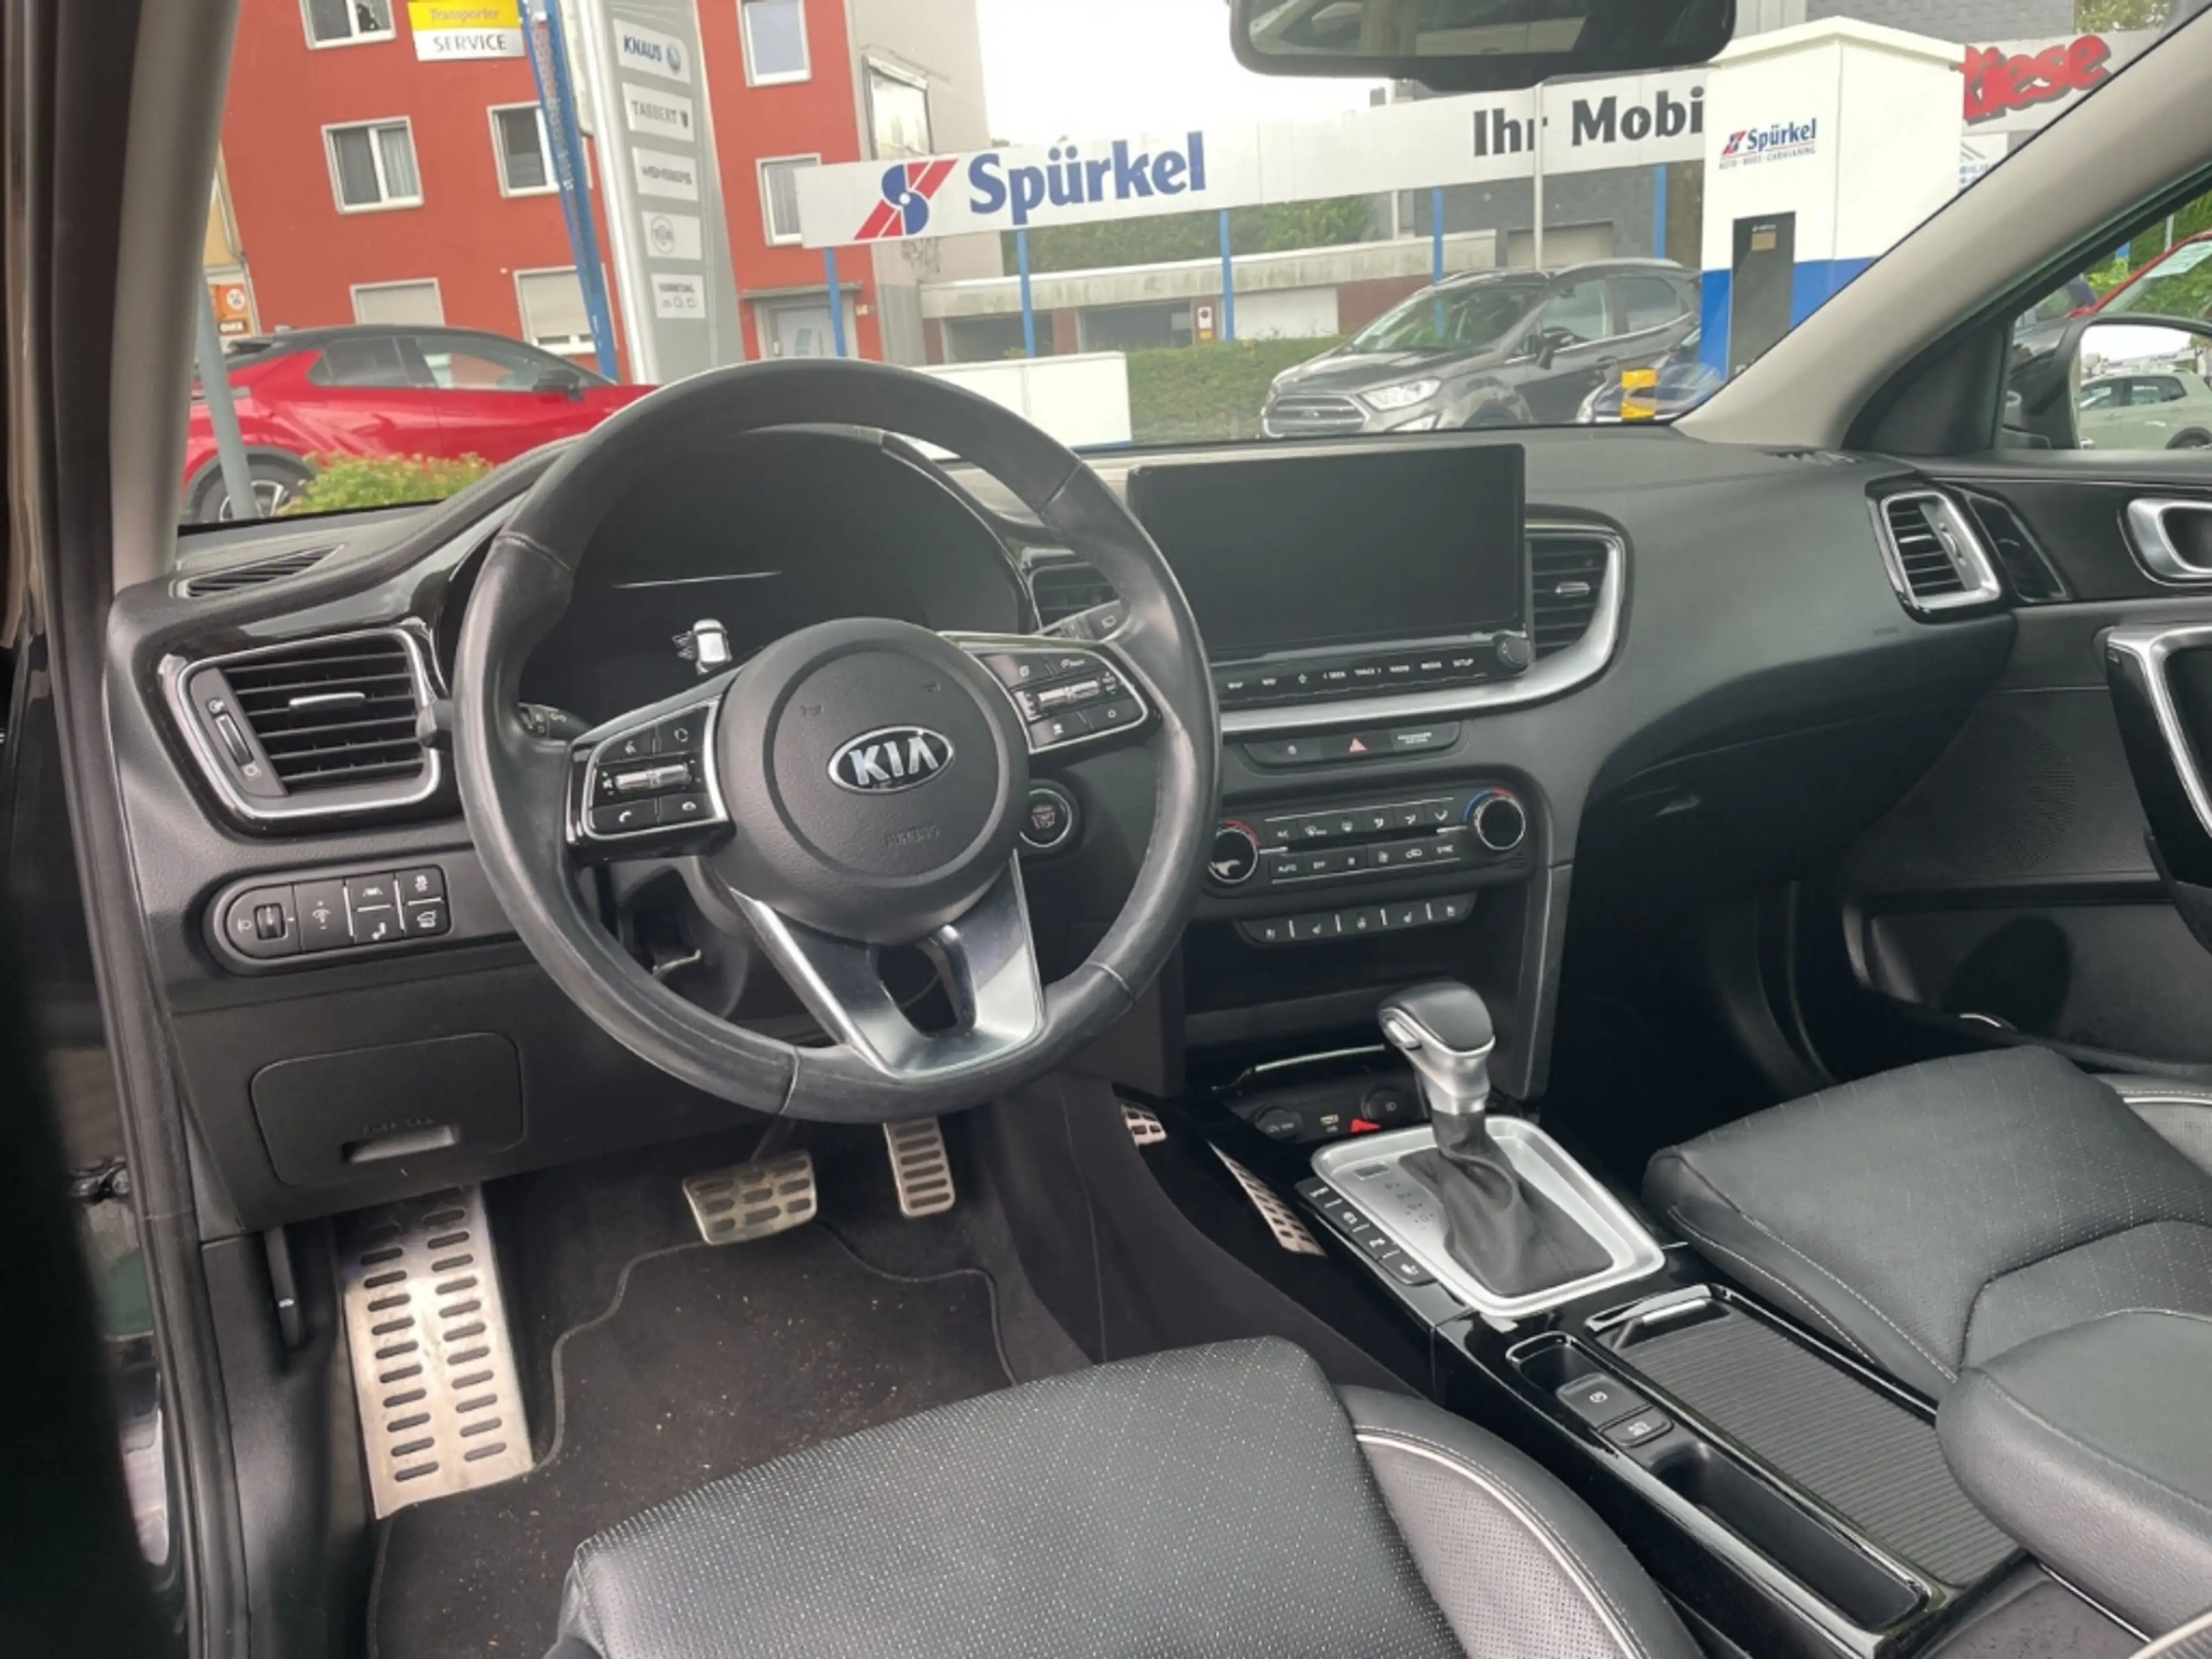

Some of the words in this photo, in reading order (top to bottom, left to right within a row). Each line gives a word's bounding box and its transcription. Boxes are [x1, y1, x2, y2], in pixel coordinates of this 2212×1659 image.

[430, 8, 499, 22] Transporter
[433, 33, 507, 51] SERVICE
[623, 35, 662, 62] KNAUS
[631, 99, 677, 124] TABBERT
[1473, 108, 1548, 157] Ihr
[1747, 117, 1817, 152] Spürkel
[968, 130, 1206, 225] Spürkel
[848, 736, 939, 785] KIA
